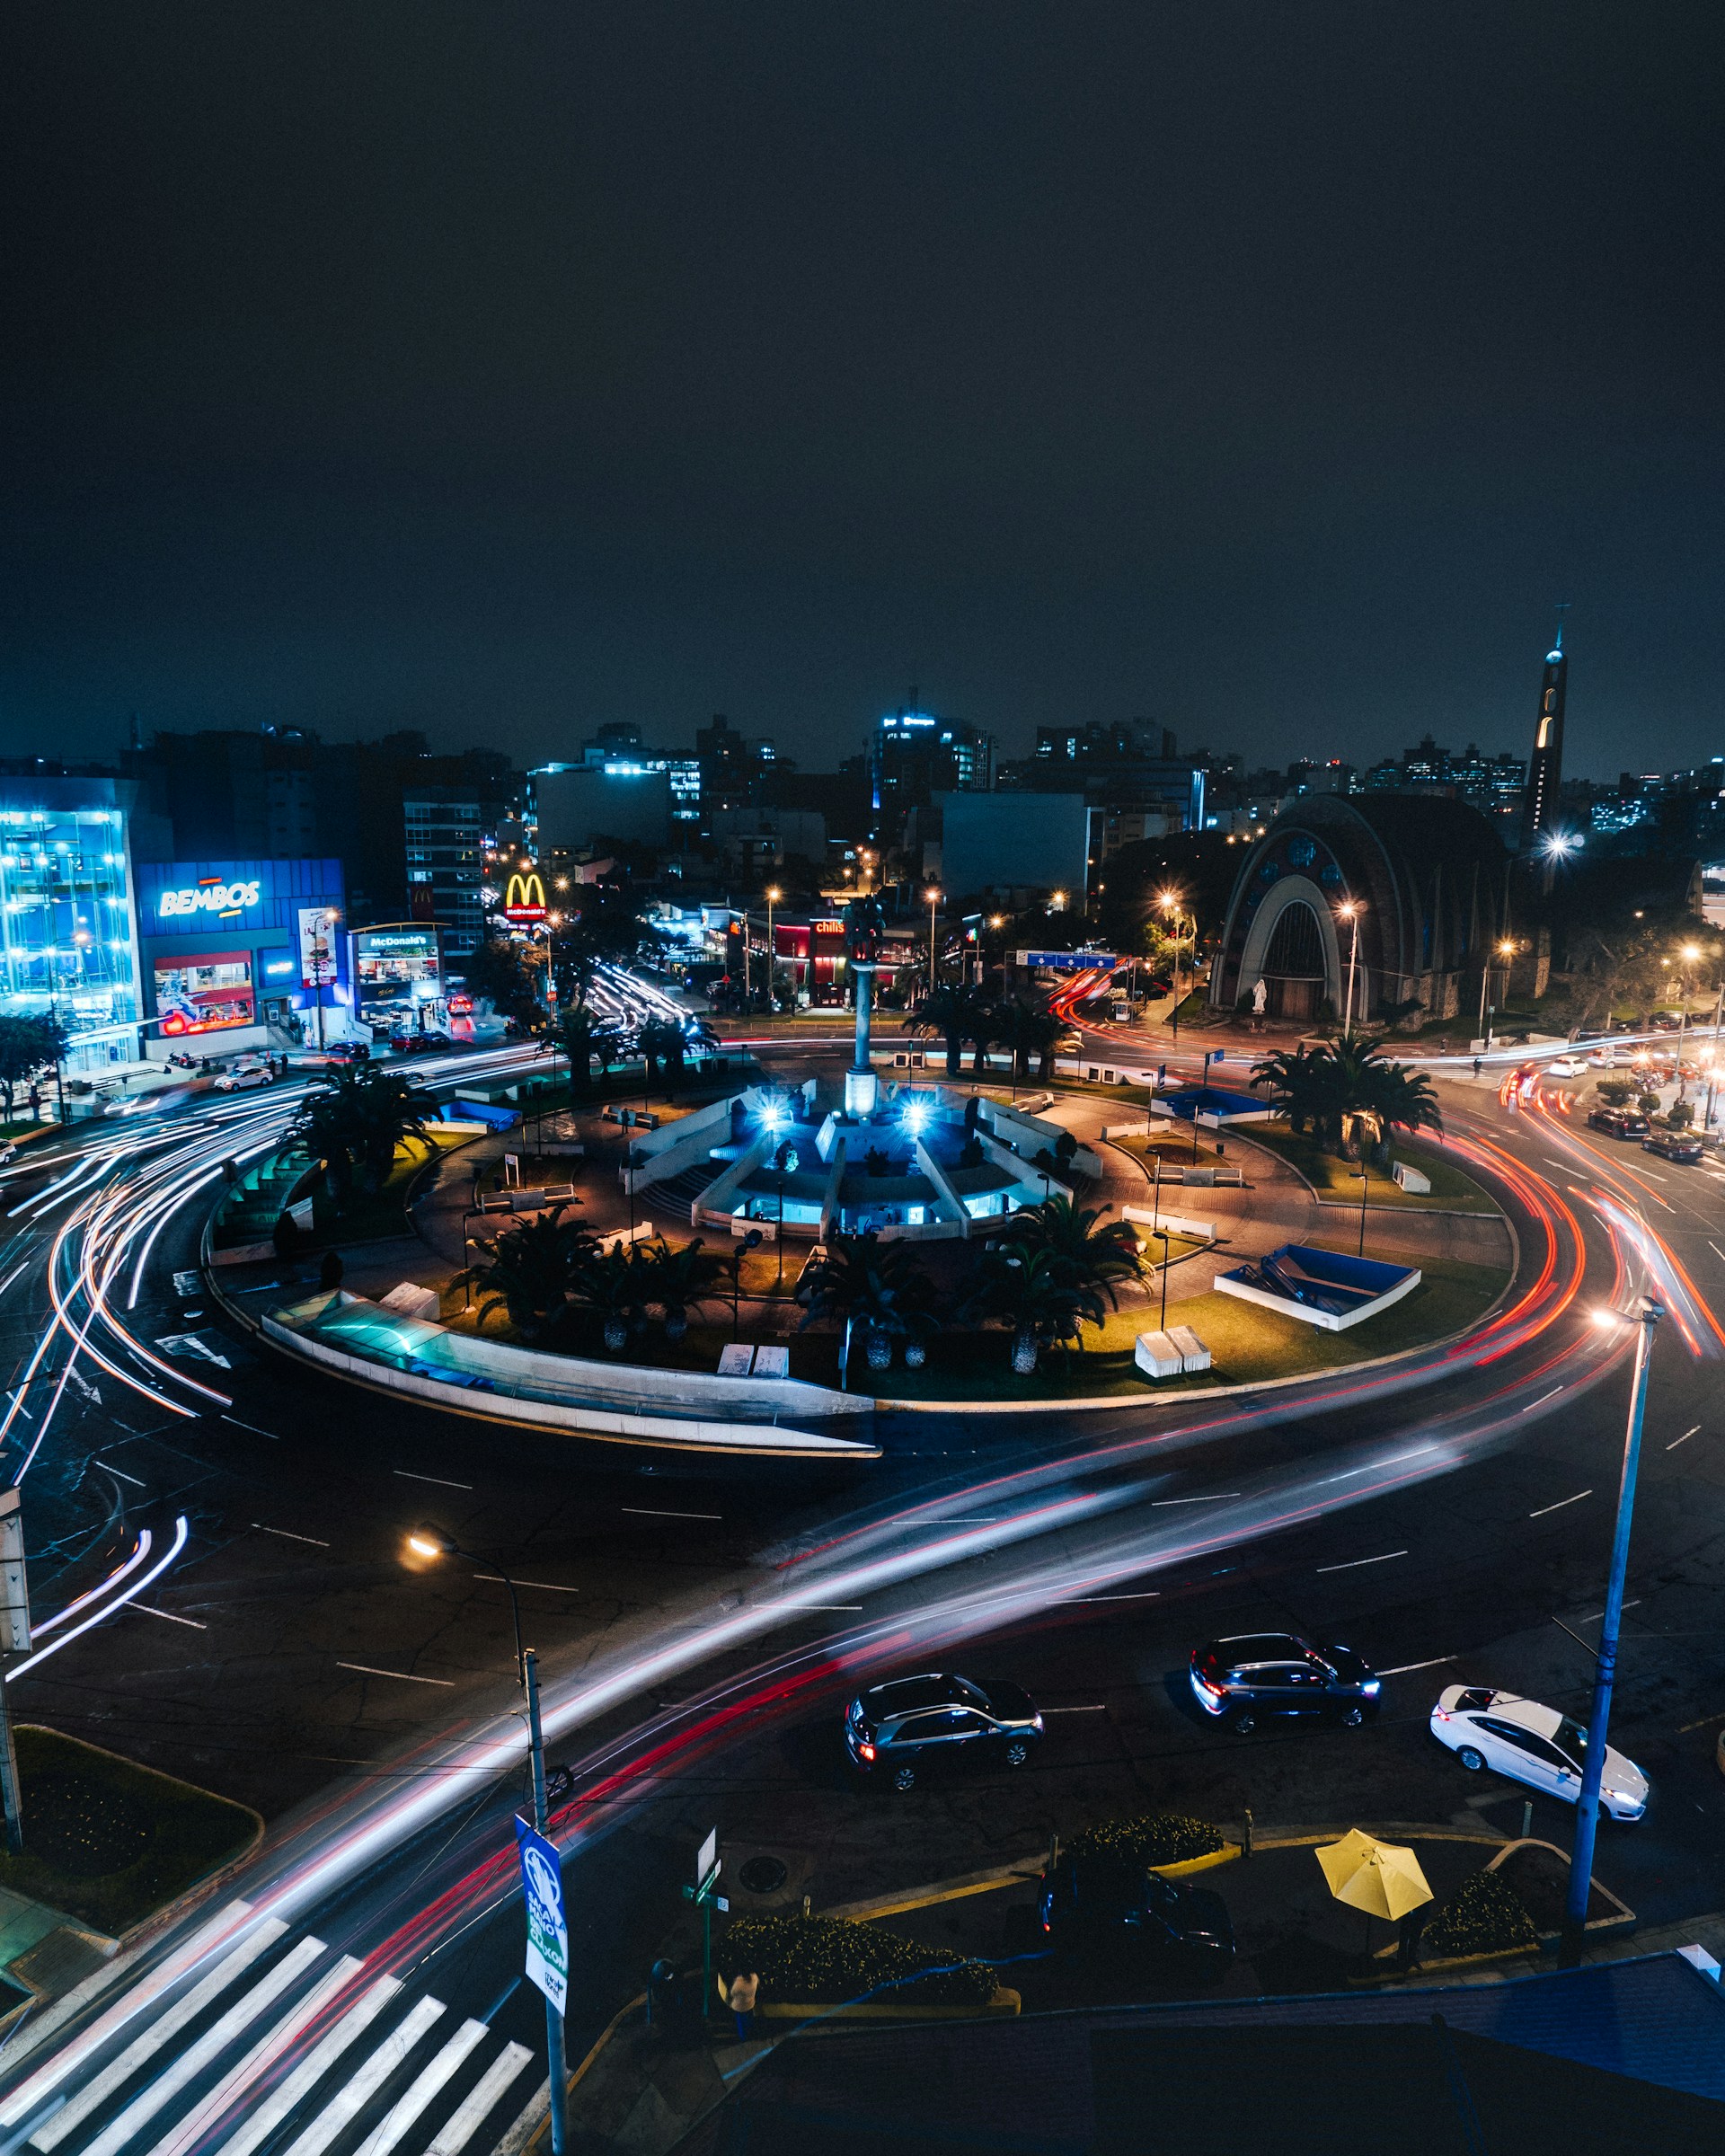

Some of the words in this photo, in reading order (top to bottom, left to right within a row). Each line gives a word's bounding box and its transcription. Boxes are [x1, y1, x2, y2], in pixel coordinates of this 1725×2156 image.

[159, 880, 261, 917] BEMBOS
[370, 936, 426, 947] McDonald's
[530, 1927, 568, 1972] CLAXON
